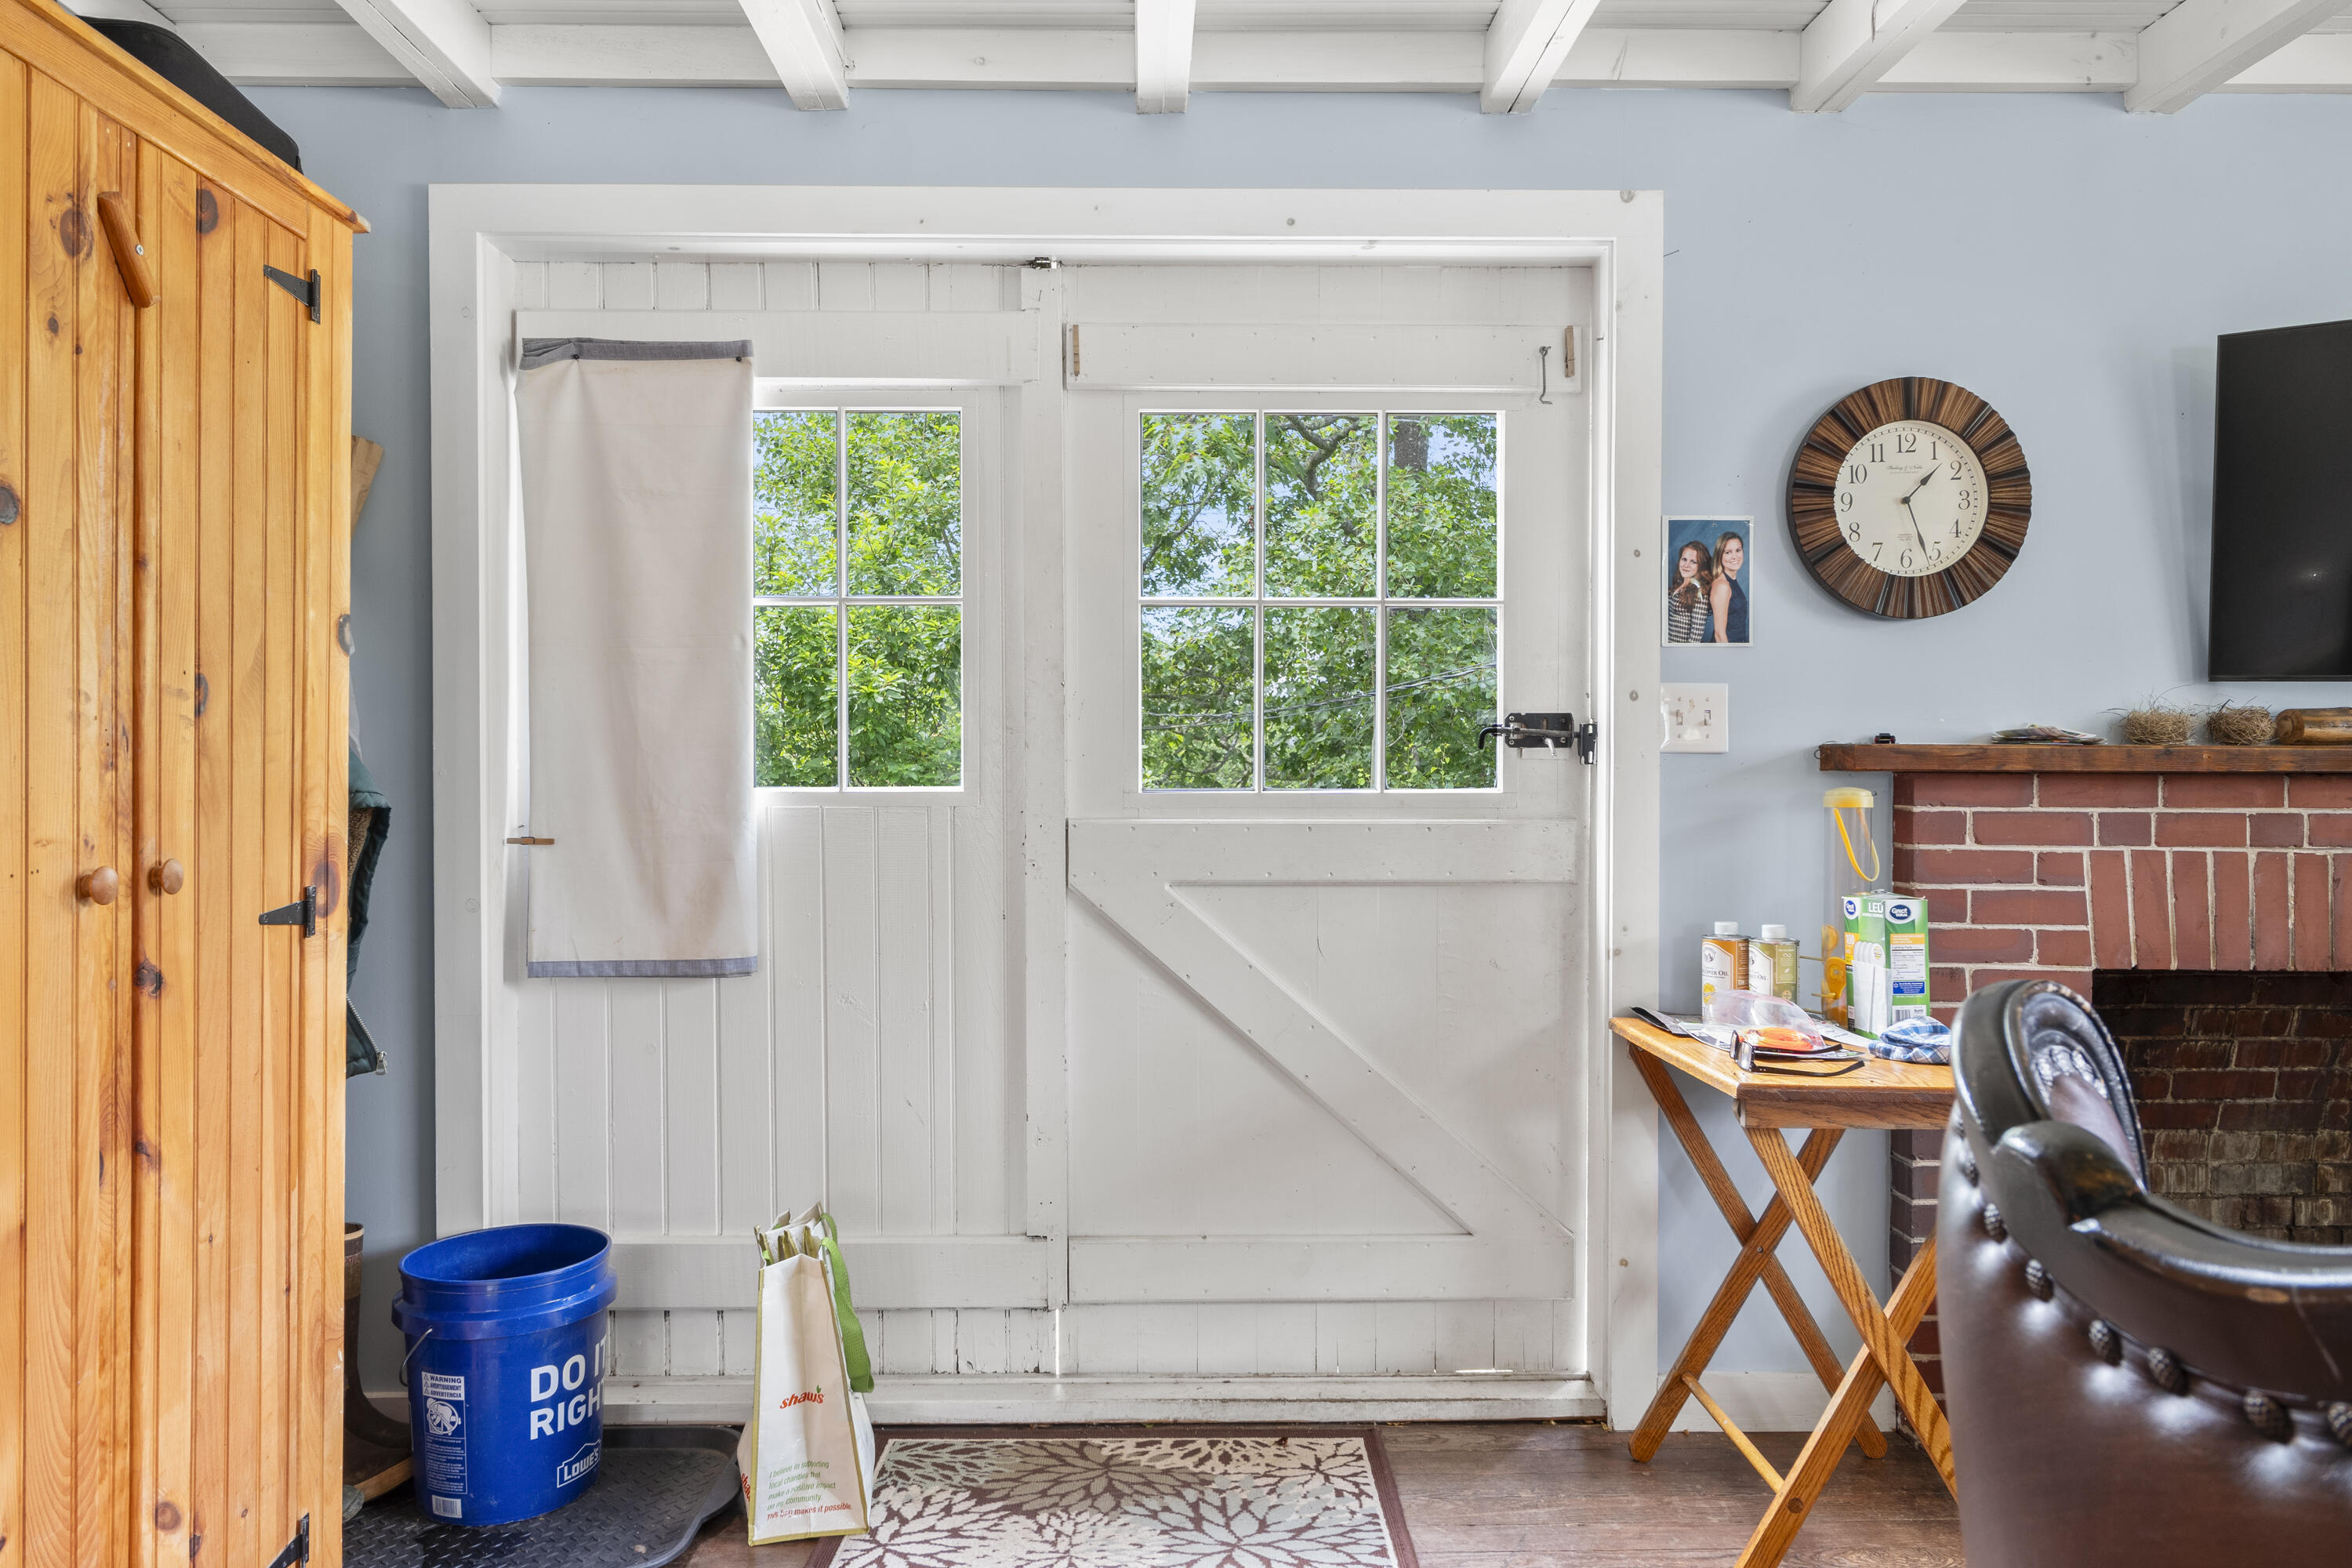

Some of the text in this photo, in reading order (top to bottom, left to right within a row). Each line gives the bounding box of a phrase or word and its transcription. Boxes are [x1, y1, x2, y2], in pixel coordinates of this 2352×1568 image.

[1896, 433, 1917, 453] 12
[1931, 441, 1938, 460] 1
[1869, 443, 1886, 463] 11
[1848, 463, 1867, 485] 10
[1950, 460, 1962, 481] 2
[1840, 492, 1853, 512] 9
[1958, 490, 1970, 510] 3
[1849, 521, 1860, 543] 8
[1949, 518, 1962, 538] 4
[1871, 542, 1883, 561] 7
[1900, 549, 1912, 568] 6
[1929, 541, 1941, 561] 5
[1868, 902, 1883, 913] LED
[531, 1334, 607, 1403] DO IT
[430, 1374, 462, 1384] WARNING
[430, 1382, 462, 1391] AVERTISSEMENT
[564, 1447, 599, 1481] LOWE'S
[773, 1465, 793, 1478] believe
[801, 1461, 829, 1469] supporting
[768, 1479, 782, 1490] local
[784, 1472, 809, 1485] charities
[768, 1491, 785, 1500] make
[789, 1483, 815, 1494] positive
[786, 1494, 822, 1504] community.
[794, 1507, 816, 1515] makes
[824, 1502, 853, 1513] possible.
